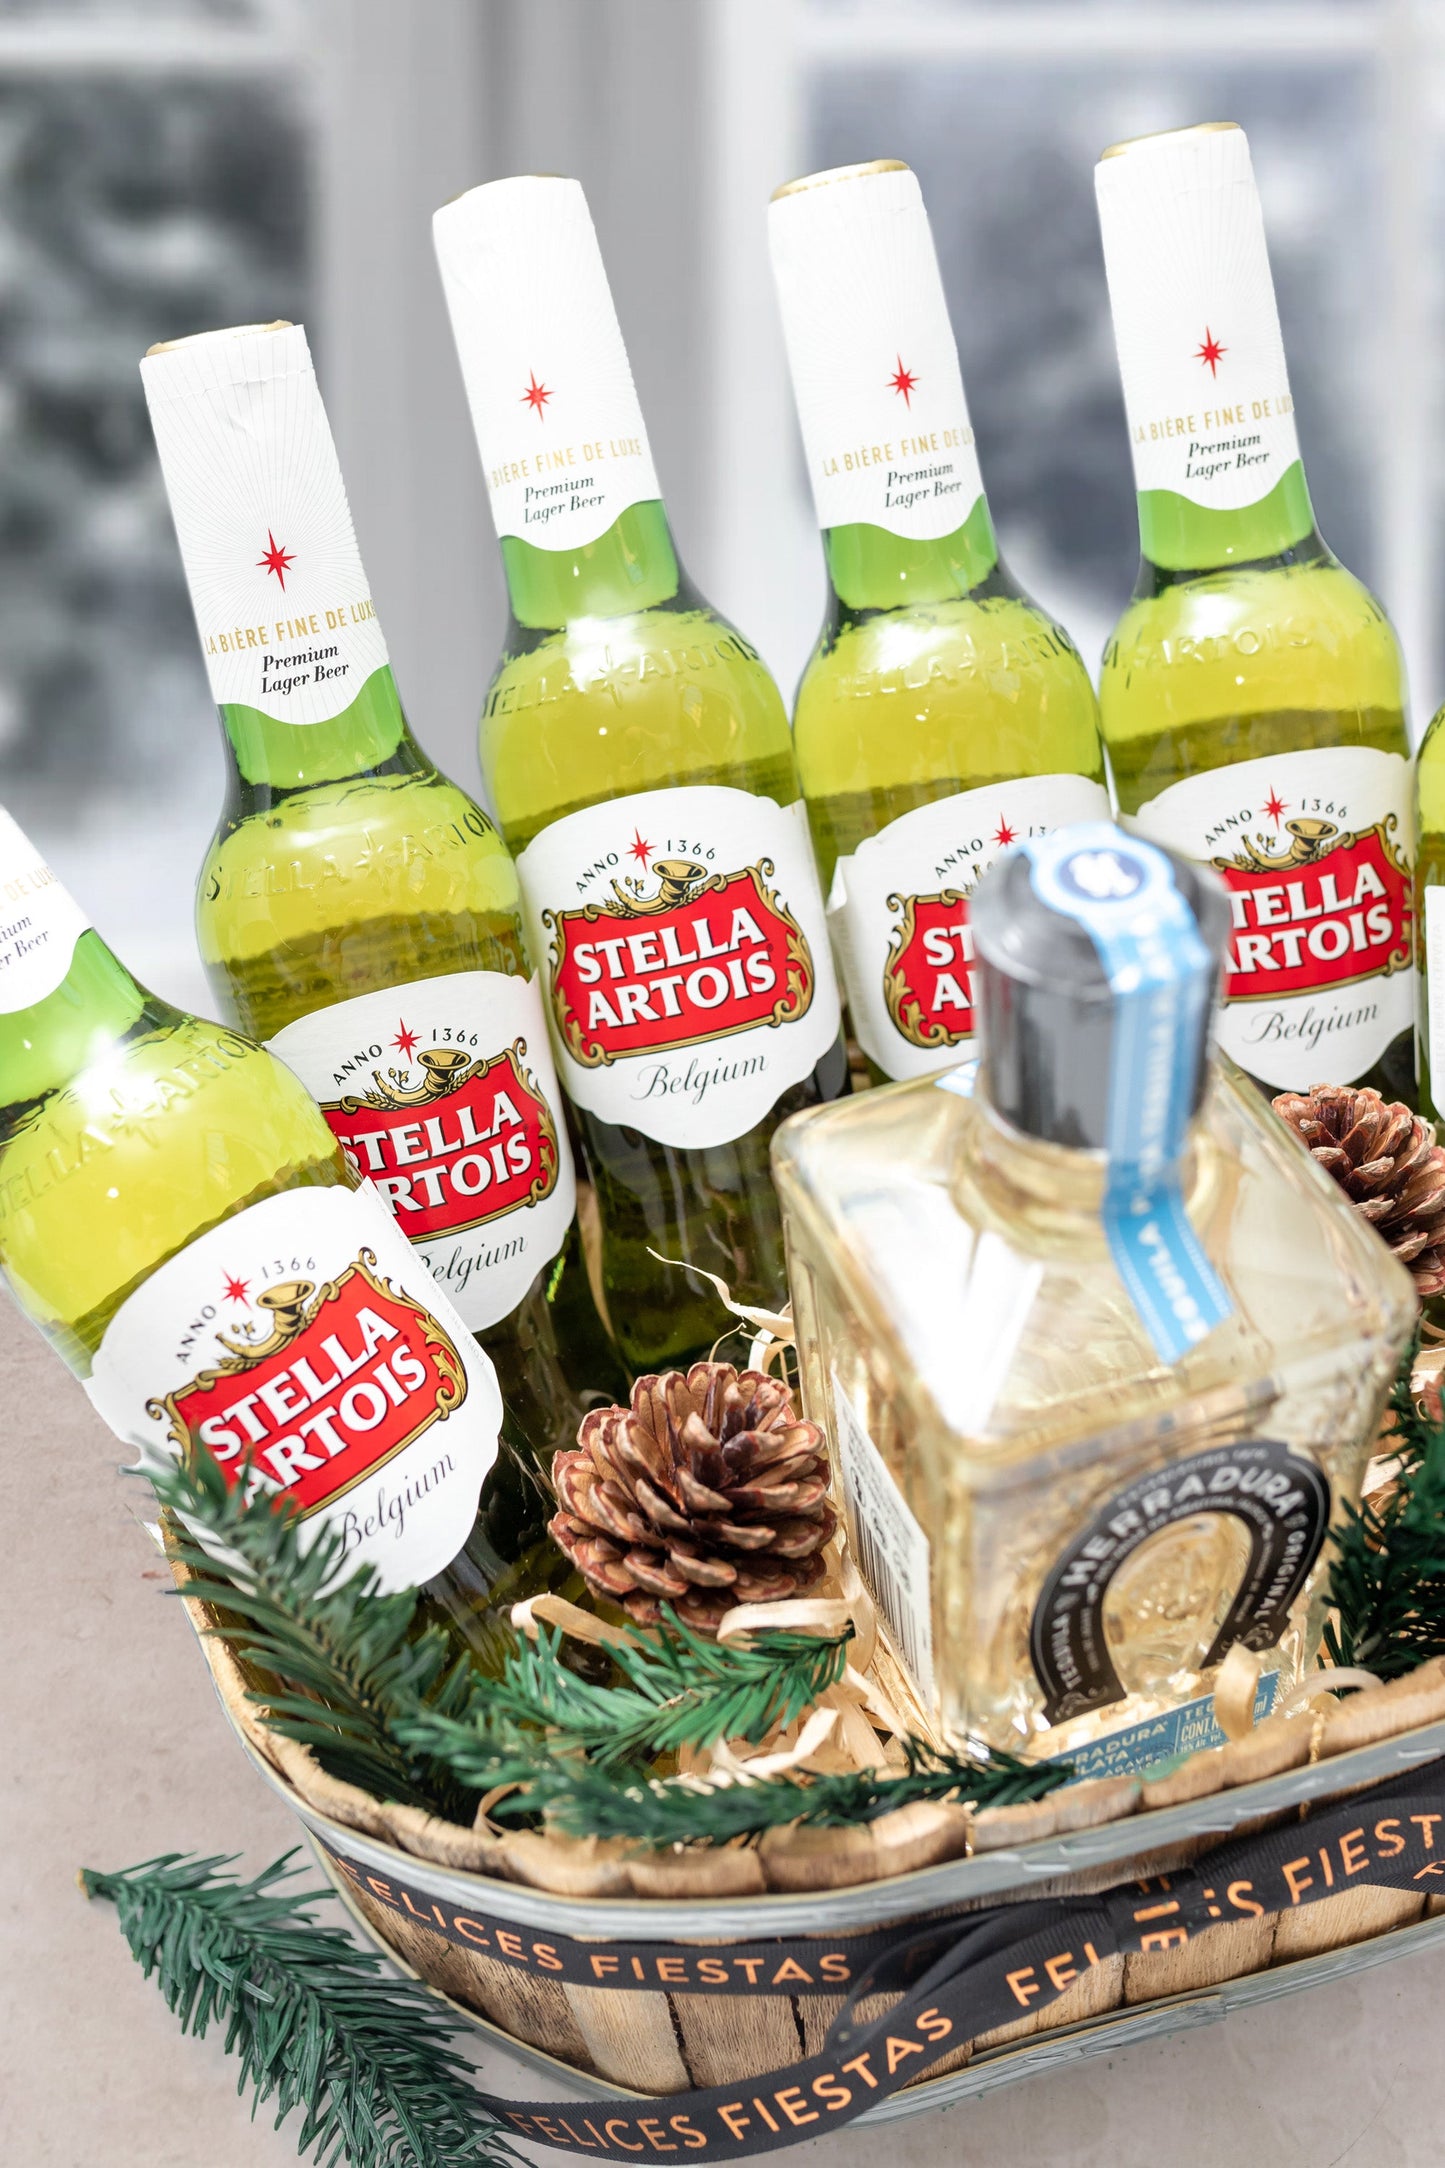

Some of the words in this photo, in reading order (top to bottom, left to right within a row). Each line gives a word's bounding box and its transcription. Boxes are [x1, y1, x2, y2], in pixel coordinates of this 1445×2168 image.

[1204, 404, 1245, 431] FINE
[1251, 399, 1272, 420] DE
[535, 447, 577, 473] FINE
[583, 441, 605, 462] DE
[609, 438, 643, 458] LUXE
[823, 458, 839, 477] LA
[900, 433, 939, 457] FINE
[943, 429, 959, 449] DE
[1185, 460, 1231, 480] Lager
[1236, 452, 1270, 469] Beer
[1188, 433, 1261, 459] Premium
[524, 477, 595, 503] Premium
[885, 489, 930, 509] Lager
[934, 481, 963, 497] Beer
[888, 463, 954, 488] Premium
[524, 502, 566, 525] Lager
[570, 495, 605, 512] Beer
[219, 626, 269, 653] BIÈRE
[275, 615, 321, 641] FINE
[326, 608, 348, 630] DE
[261, 673, 310, 696] Lager
[314, 664, 350, 683] Beer
[262, 646, 340, 673] Premium
[1204, 809, 1253, 847] ANNO
[1300, 799, 1349, 819] 1366
[575, 852, 620, 894] ANNO
[666, 839, 716, 860] 1366
[934, 838, 984, 879] ANNO
[1228, 863, 1388, 930] TELLA
[14, 931, 48, 958] Beer
[572, 906, 768, 985] STELLA
[587, 951, 778, 1031] ARTOIS
[1242, 1002, 1381, 1051] Belgium
[332, 1043, 383, 1086] ANNO
[432, 1027, 479, 1047] 1366
[630, 1054, 769, 1105] Belgium
[373, 1131, 532, 1215] RTOIS
[176, 1305, 217, 1365] ANNO
[262, 1256, 316, 1279] 1366
[199, 1306, 402, 1464] STELLA
[234, 1343, 427, 1511] ARTOIS
[329, 1452, 459, 1563] Belgium
[1061, 1465, 1308, 1587] HERRADURA
[1253, 1530, 1307, 1621] ORIGINAL
[337, 1857, 564, 1973] FELICES
[589, 1952, 853, 1987] FIESTAS
[506, 2110, 708, 2153] FELICES
[716, 2007, 953, 2141] FIESTAS
